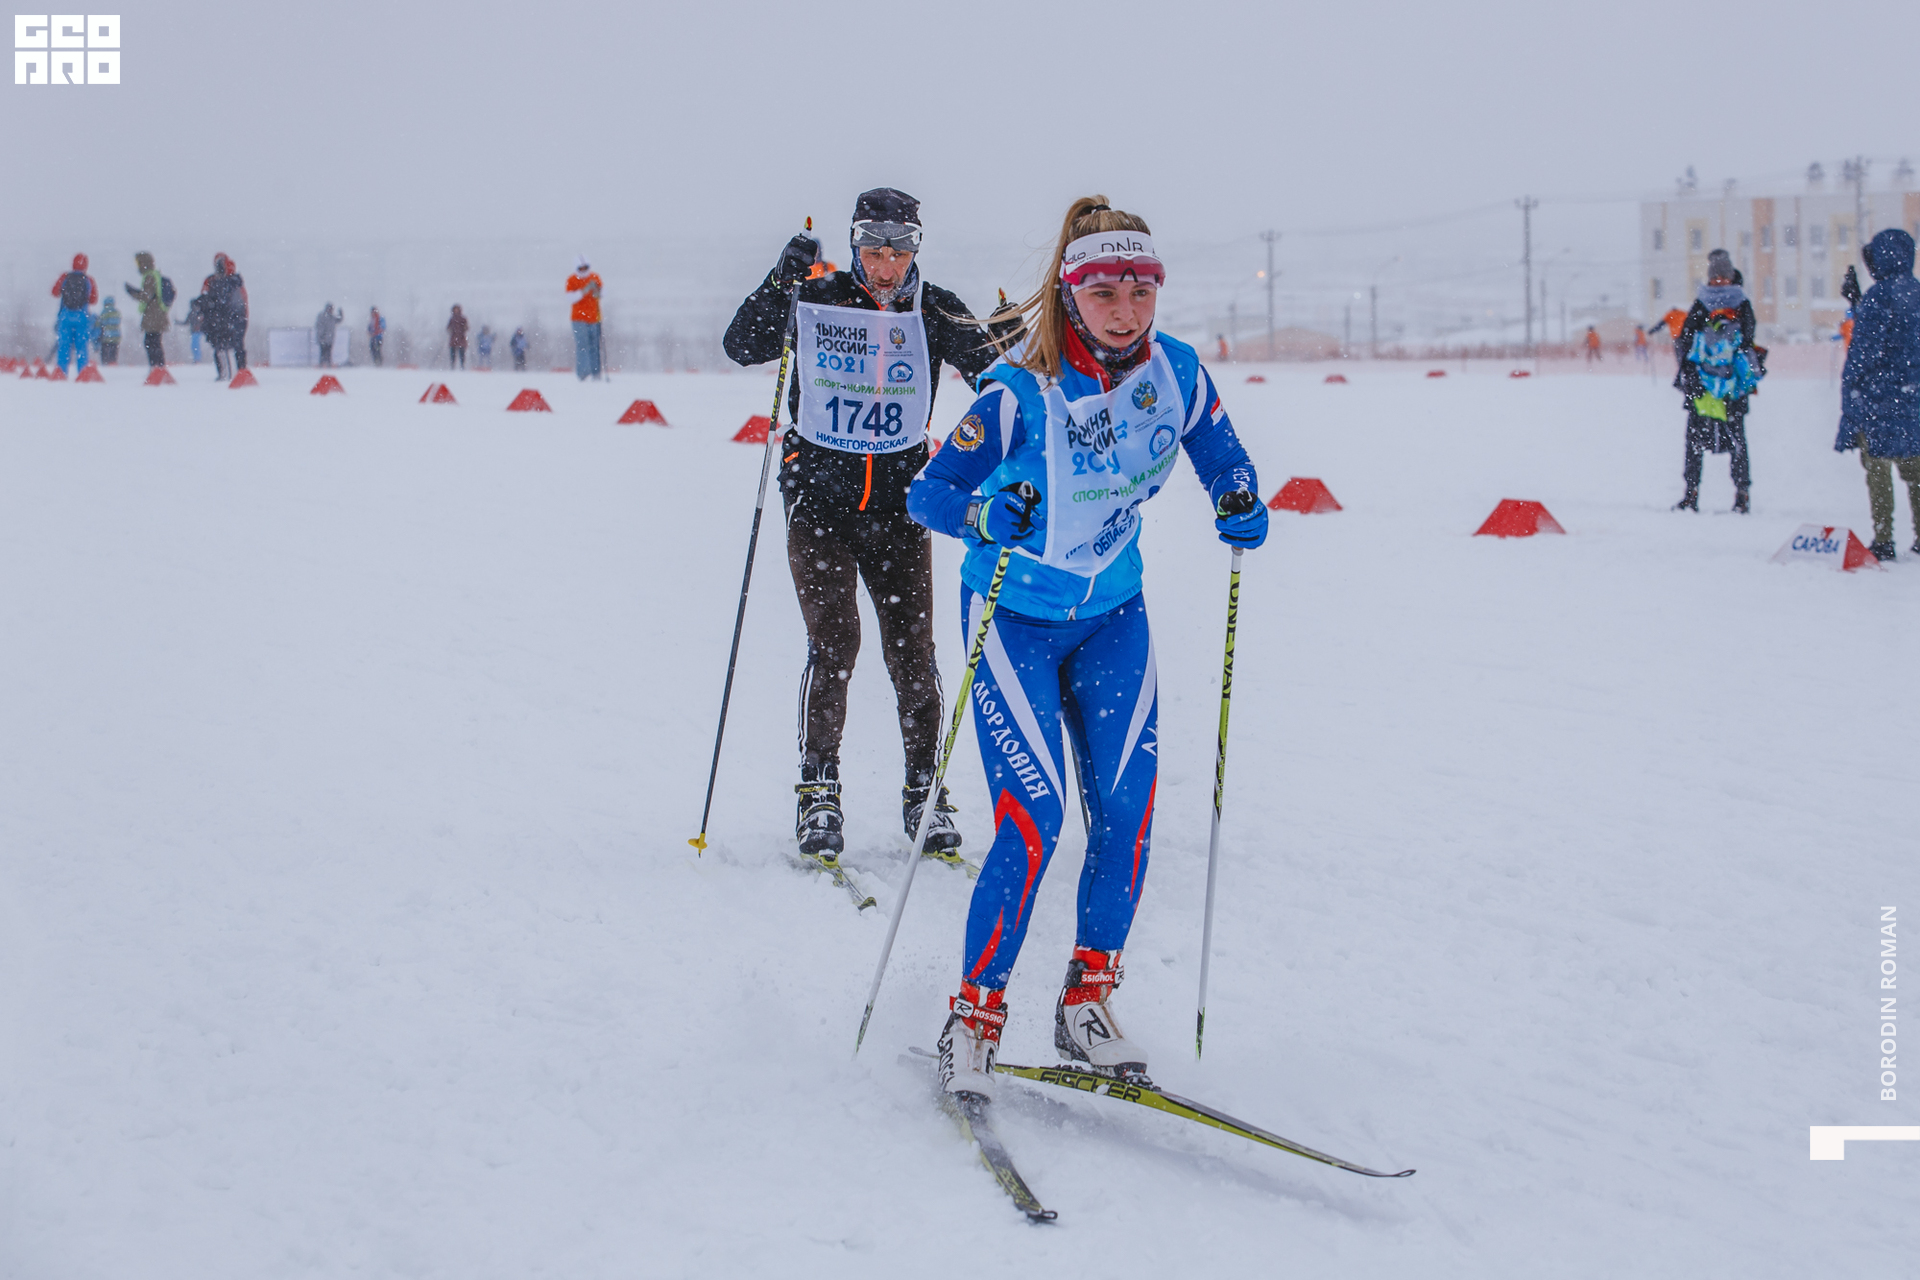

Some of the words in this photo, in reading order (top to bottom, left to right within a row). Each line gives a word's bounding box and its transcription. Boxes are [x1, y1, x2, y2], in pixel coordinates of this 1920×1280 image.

[816, 336, 867, 356] РОССИИ
[816, 351, 865, 374] 2021
[814, 378, 841, 391] СПОРТ
[847, 383, 881, 395] НОРМА
[882, 386, 916, 396] ЖИЗНИ
[825, 395, 903, 438] 1748
[816, 430, 909, 453] НИЖЕГОРОДСКАЯ
[1072, 487, 1110, 503] СПОРТ
